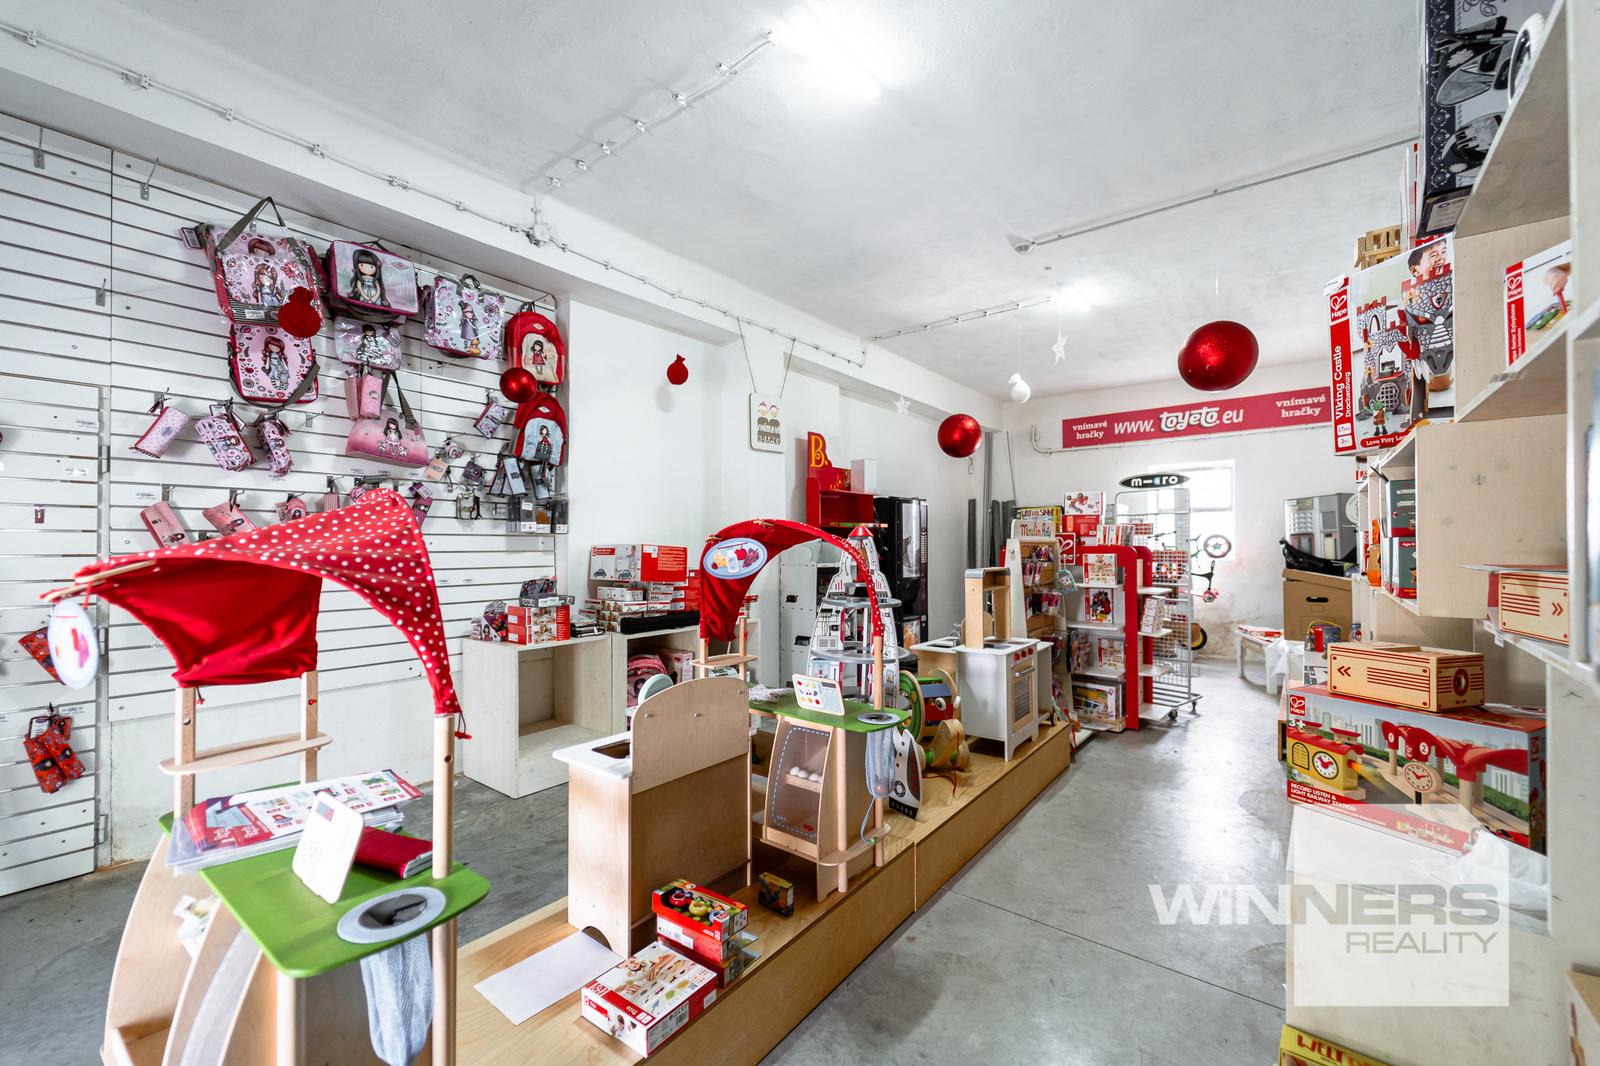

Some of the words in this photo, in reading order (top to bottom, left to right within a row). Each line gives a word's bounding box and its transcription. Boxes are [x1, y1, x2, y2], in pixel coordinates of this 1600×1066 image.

[1331, 308, 1347, 319] Hape
[1333, 345, 1343, 381] Castle
[1072, 420, 1108, 431] vnímavé
[1276, 394, 1327, 407] vnímavé
[1335, 383, 1345, 420] Viking
[1076, 430, 1105, 440] hračky
[1281, 406, 1321, 418] hračky
[1290, 707, 1305, 715] Hape
[1289, 719, 1306, 729] 3+
[1290, 783, 1311, 793] RECORD
[1312, 789, 1330, 799] LISTEN
[1290, 788, 1306, 797] LIGHT
[1306, 793, 1331, 804] RAILWAY
[1332, 801, 1357, 812] STATION
